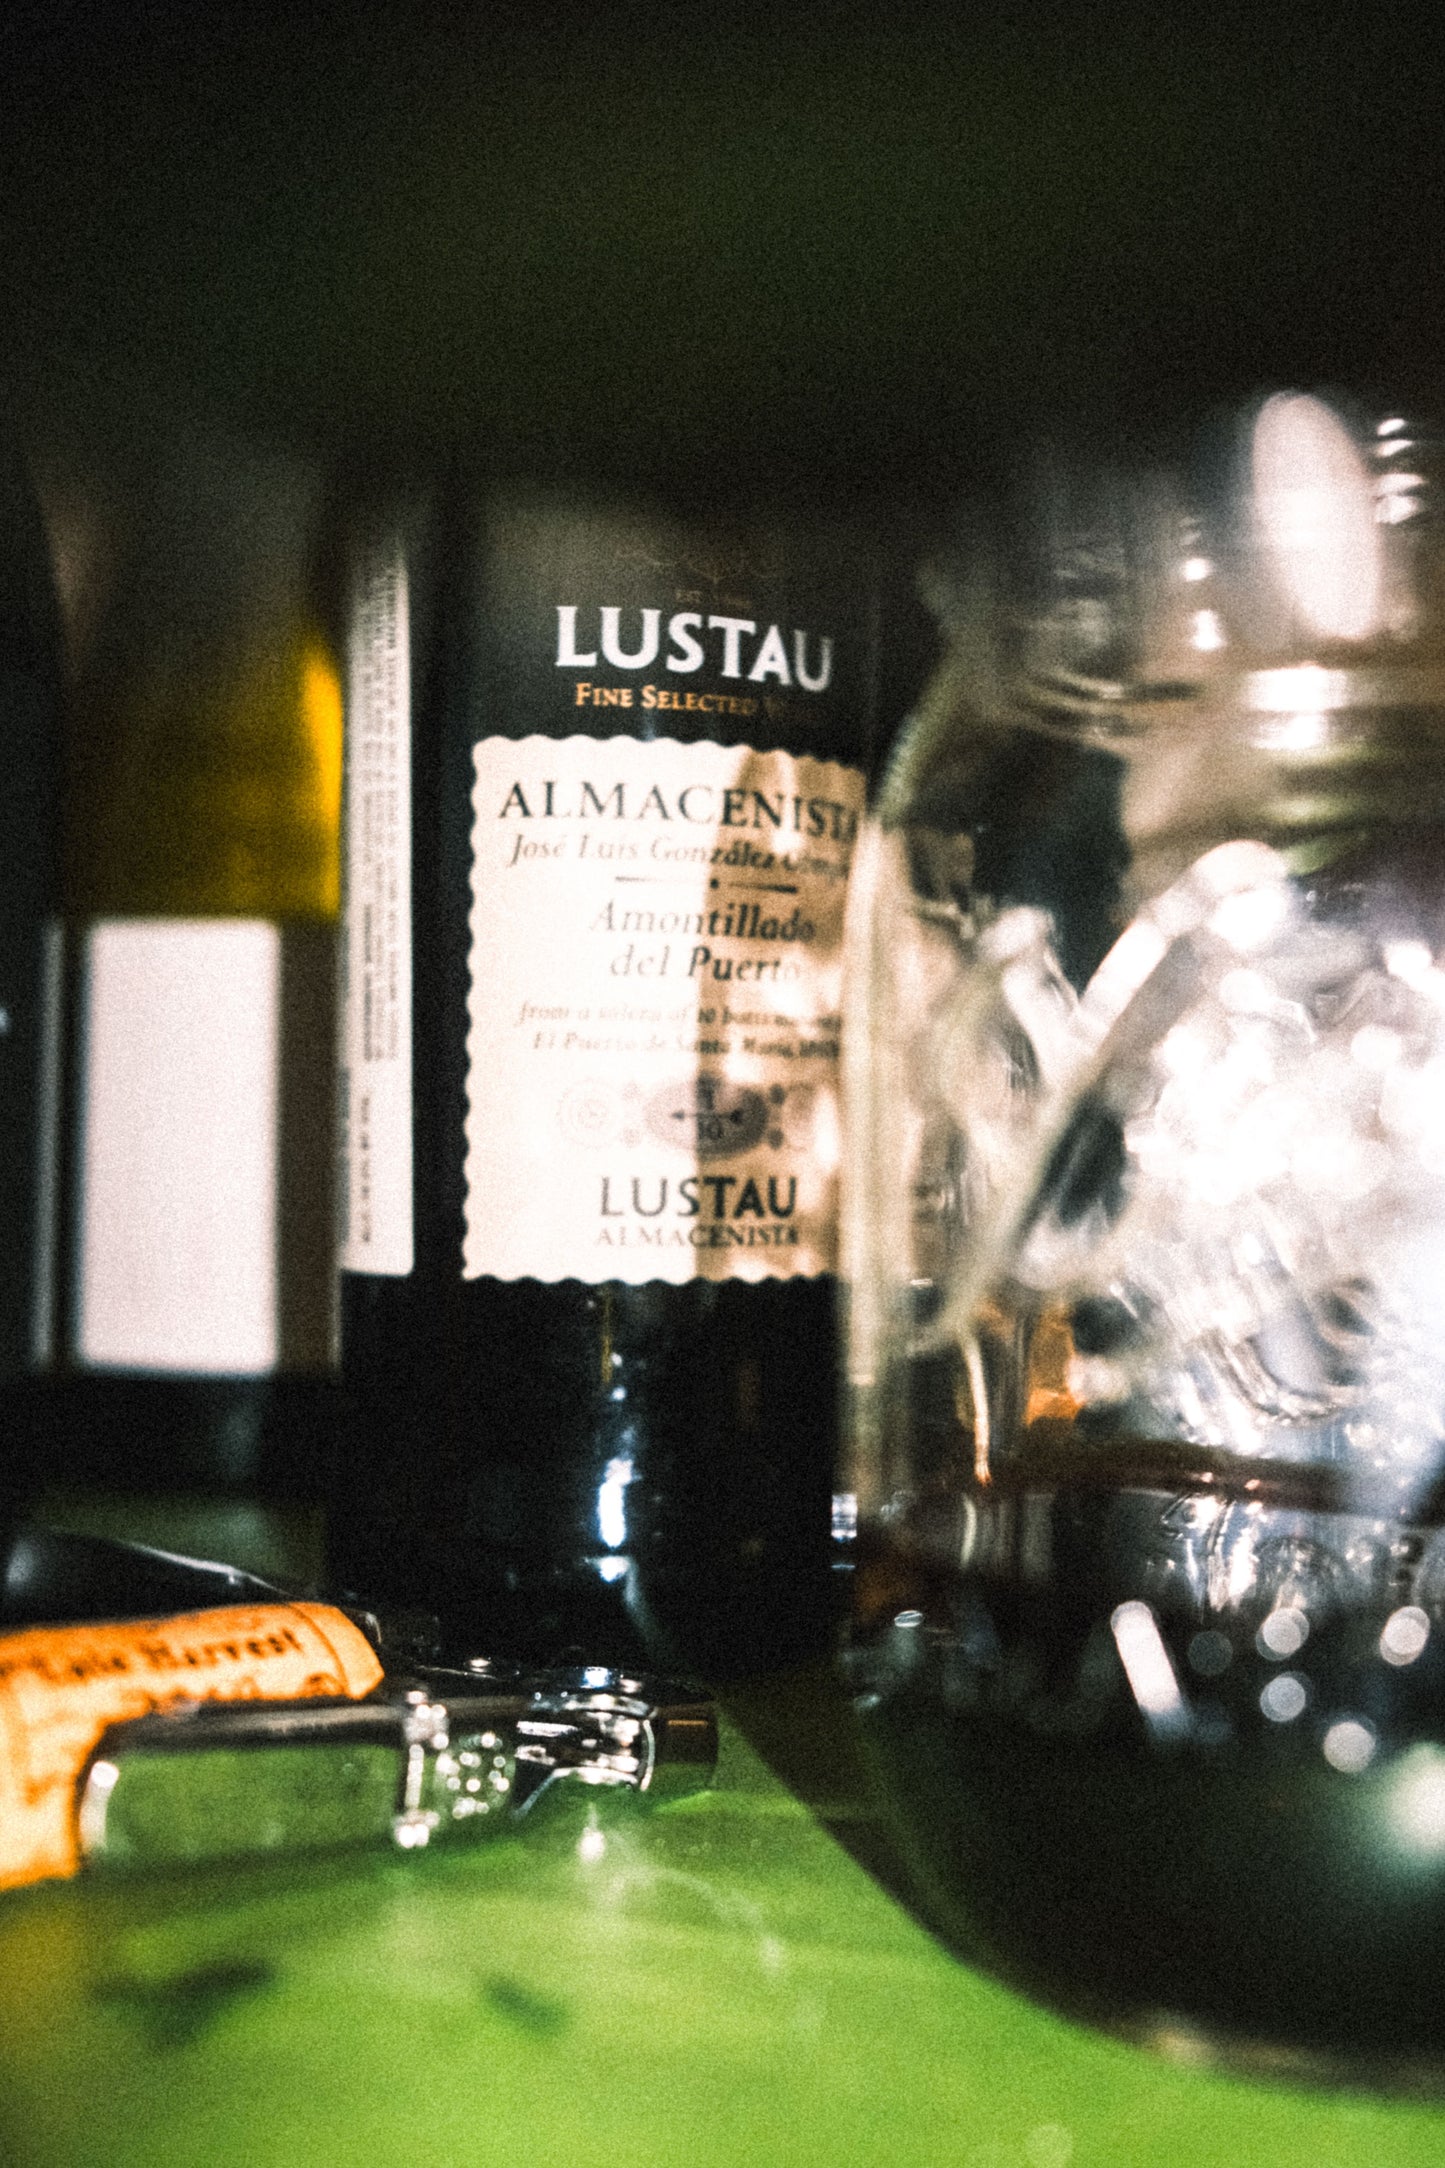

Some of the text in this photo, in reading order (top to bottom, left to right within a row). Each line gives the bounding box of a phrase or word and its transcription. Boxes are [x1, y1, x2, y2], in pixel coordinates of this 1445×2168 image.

[556, 605, 833, 692] LUSTAU
[506, 833, 566, 867] José
[578, 833, 639, 860] Luis
[590, 899, 815, 942] Amontillado
[609, 943, 802, 982] del Puerto
[601, 1176, 797, 1218] LUSTAU
